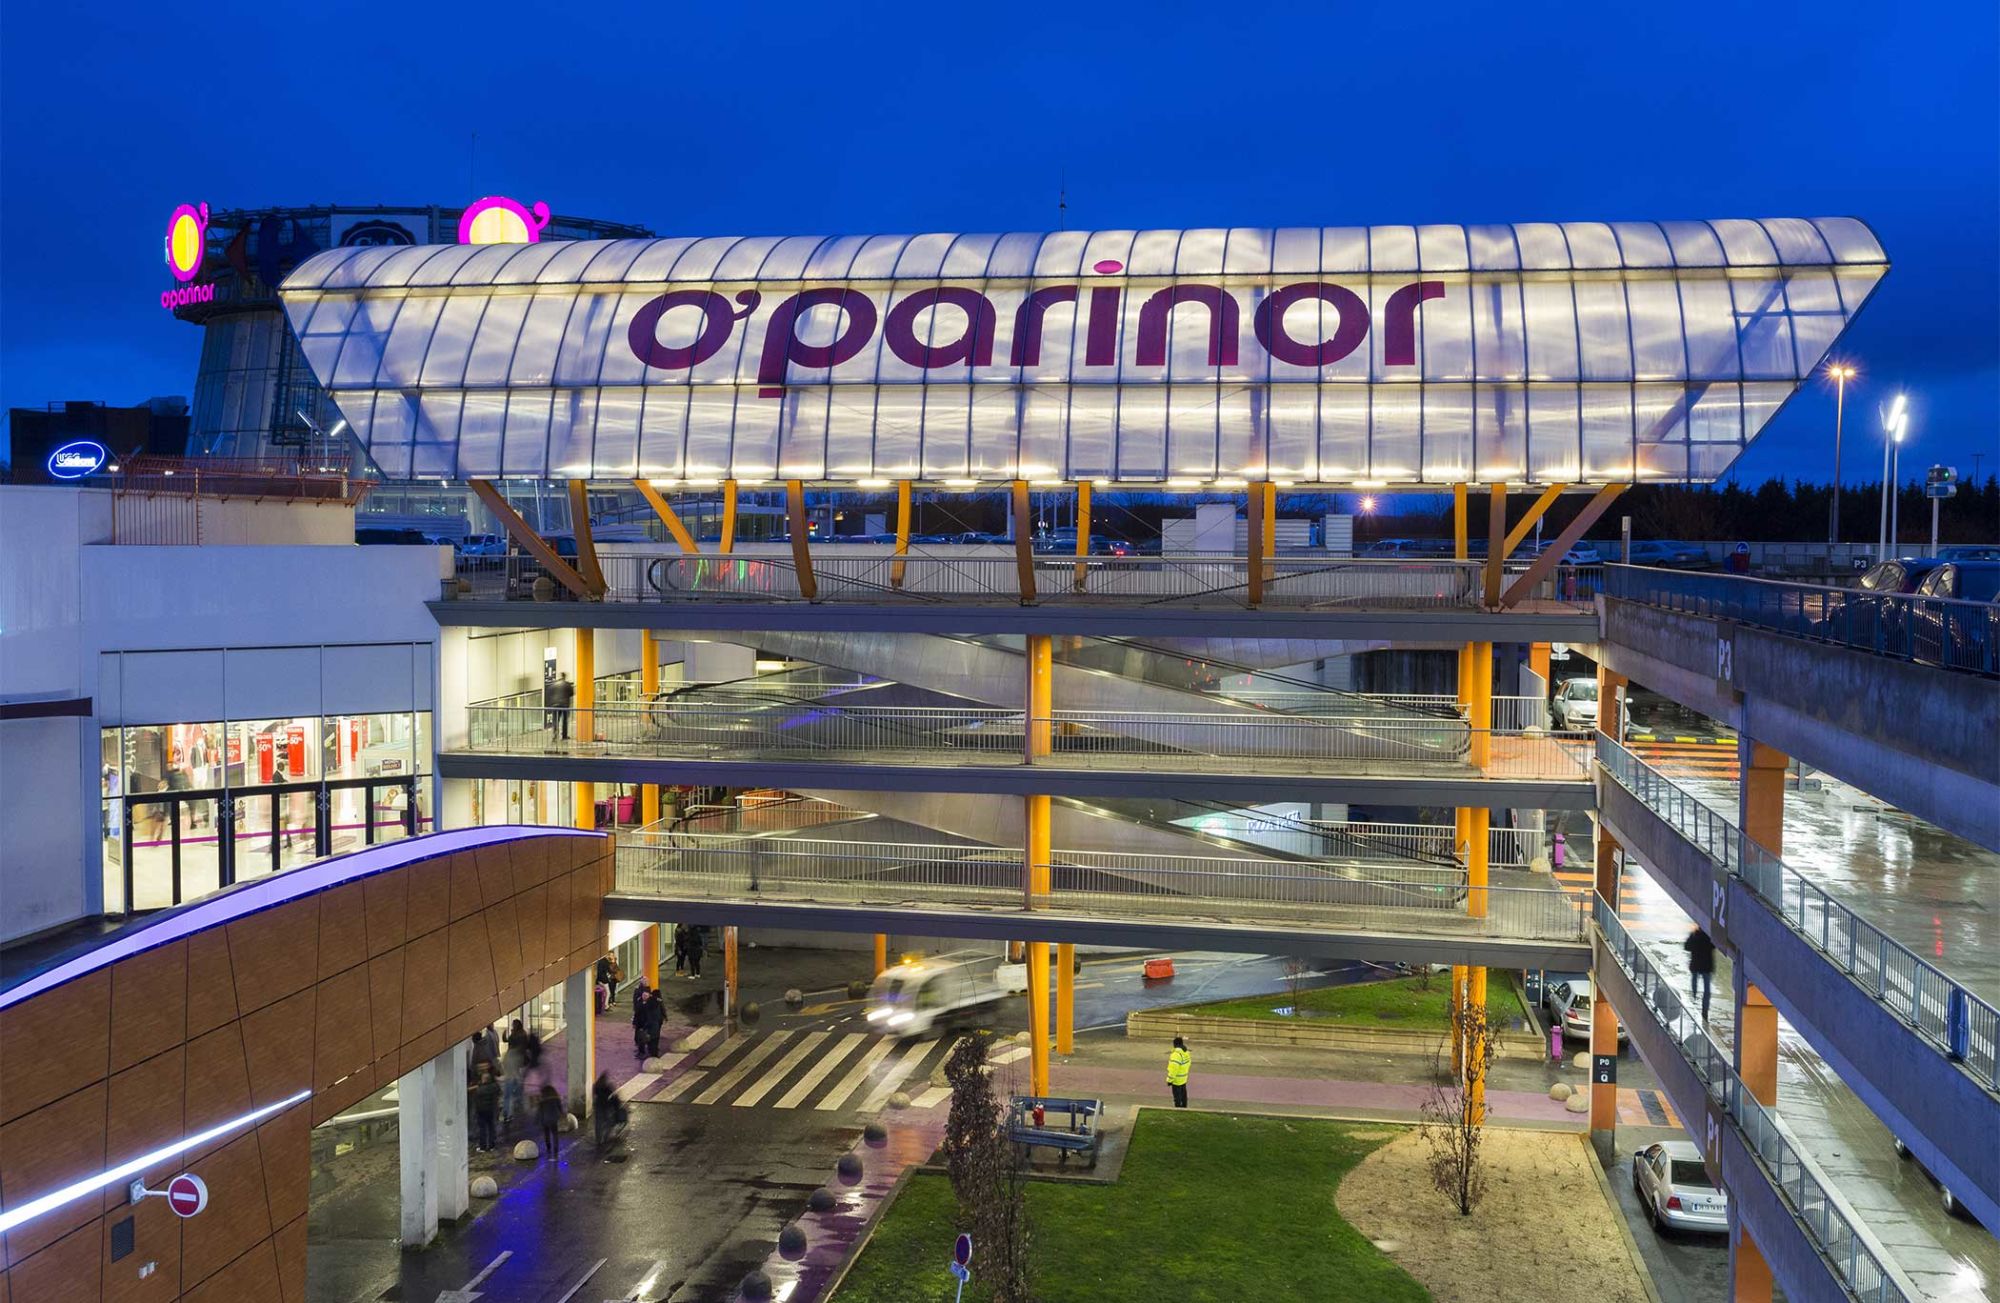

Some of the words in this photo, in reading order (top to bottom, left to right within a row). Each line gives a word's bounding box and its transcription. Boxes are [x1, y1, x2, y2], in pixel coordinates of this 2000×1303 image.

[628, 260, 1445, 398] o'parinor
[1853, 559, 1867, 569] P3
[1718, 638, 1731, 681] P3
[1712, 880, 1726, 929] P2
[1600, 1073, 1609, 1082] Q
[1706, 1111, 1719, 1165] P1
